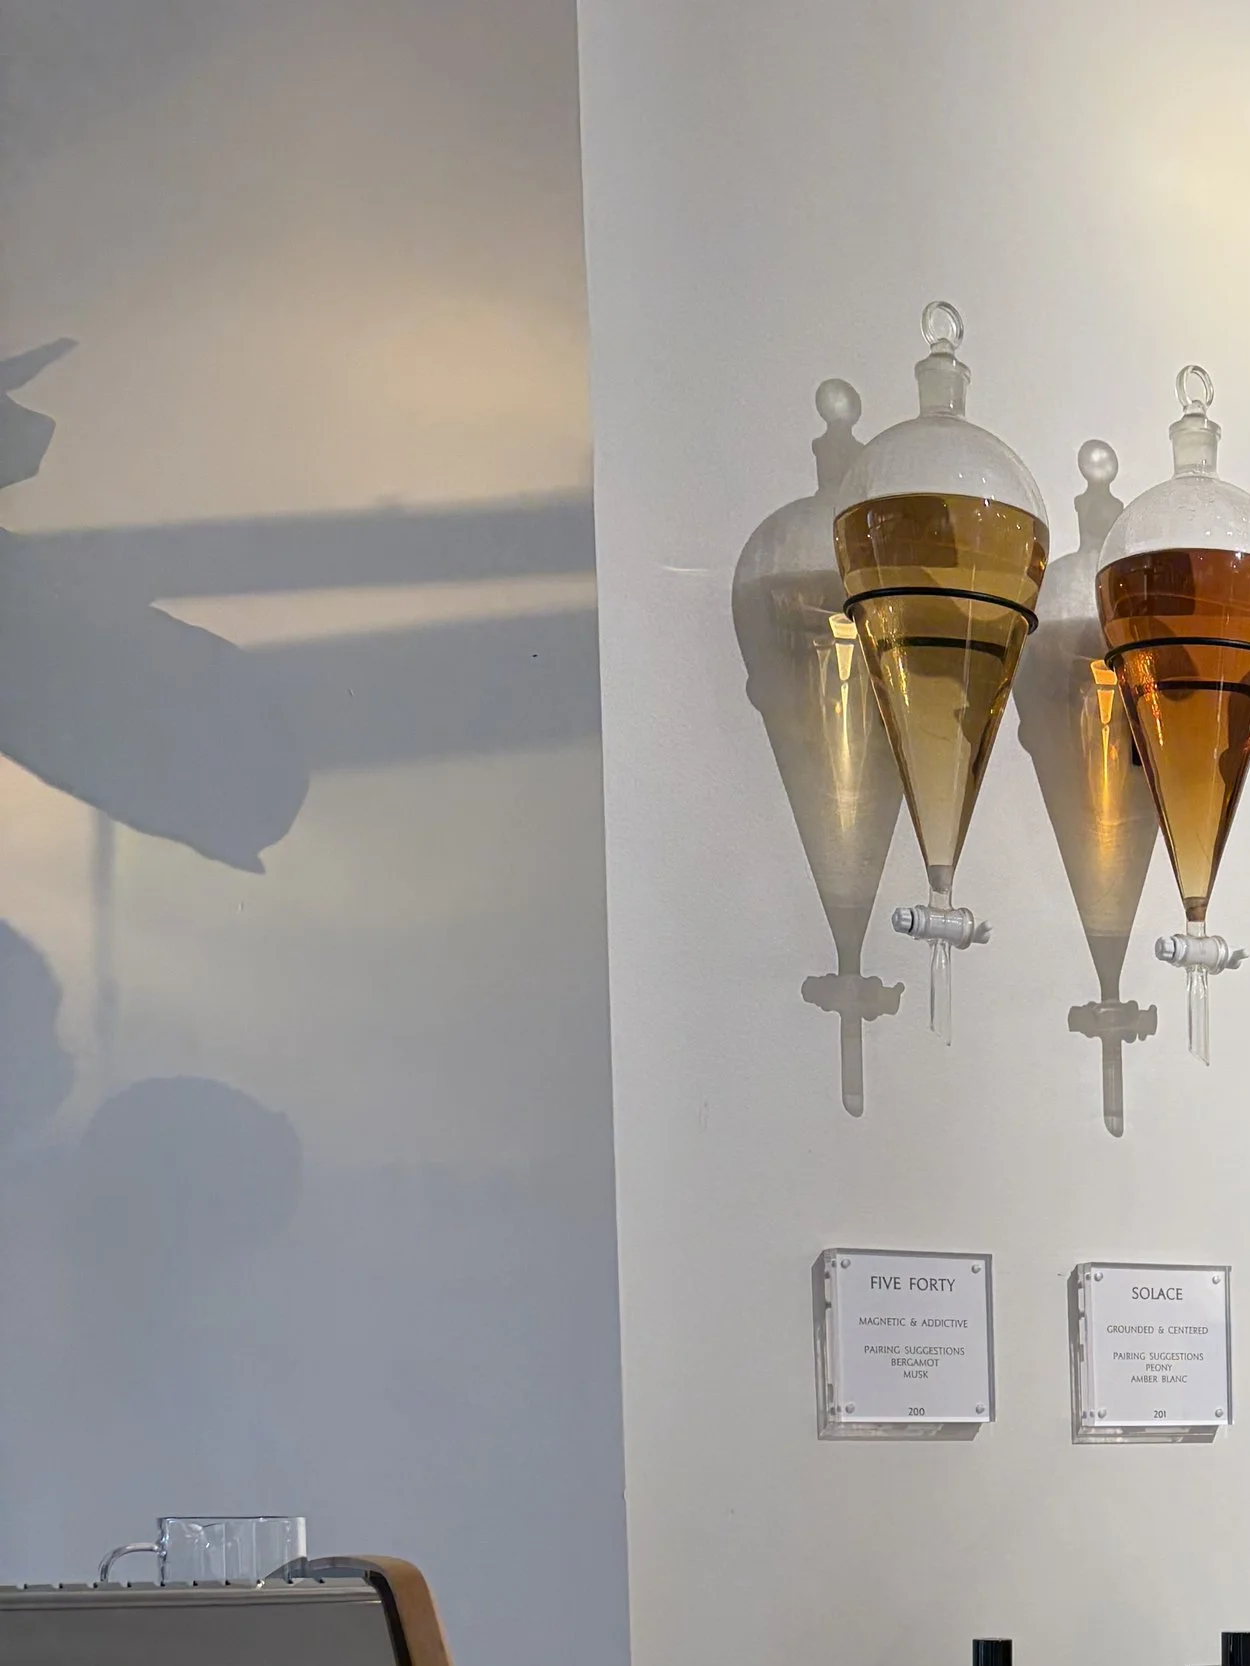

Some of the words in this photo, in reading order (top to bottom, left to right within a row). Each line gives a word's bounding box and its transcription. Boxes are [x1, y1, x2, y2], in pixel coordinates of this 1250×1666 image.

[870, 1276, 901, 1290] FIVE
[909, 1278, 956, 1292] FORTY
[1132, 1287, 1183, 1300] SOLACE
[859, 1318, 905, 1327] MAGNETIC
[910, 1319, 917, 1327] &
[922, 1319, 968, 1328] ADDICTIVE
[1107, 1325, 1154, 1334] GROUNDED
[1168, 1326, 1209, 1335] CENTERED
[864, 1346, 900, 1354] PAIRING
[905, 1347, 965, 1356] SUGGESTIONS
[1113, 1352, 1145, 1360] PAIRING
[1149, 1353, 1204, 1361] SUGGESTIONS
[891, 1359, 939, 1367] BERGAMOT
[1146, 1364, 1172, 1372] PEONY
[904, 1371, 928, 1379] MUSK
[908, 1408, 925, 1416] 200
